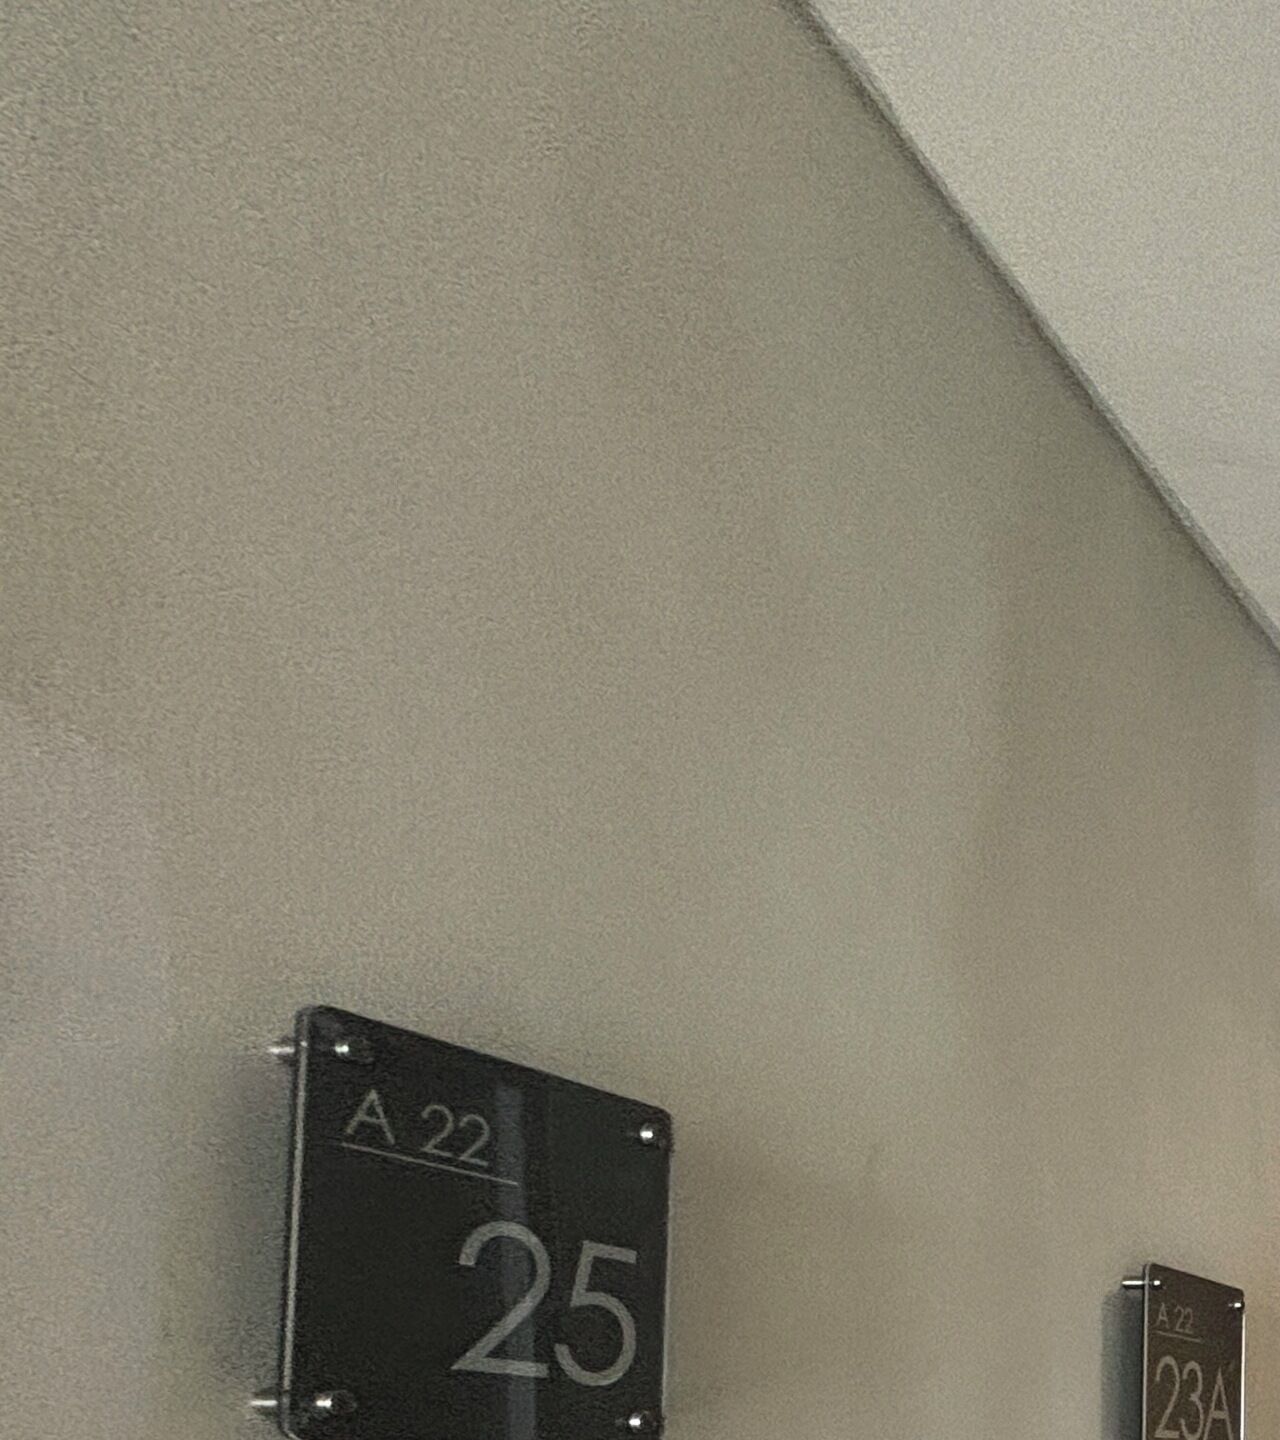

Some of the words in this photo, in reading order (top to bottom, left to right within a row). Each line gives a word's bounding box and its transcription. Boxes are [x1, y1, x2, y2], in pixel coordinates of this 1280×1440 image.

[346, 1089, 395, 1146] A
[420, 1104, 490, 1166] 22
[450, 1221, 637, 1387] 25
[1156, 1302, 1170, 1329] A
[1174, 1305, 1194, 1335] 22
